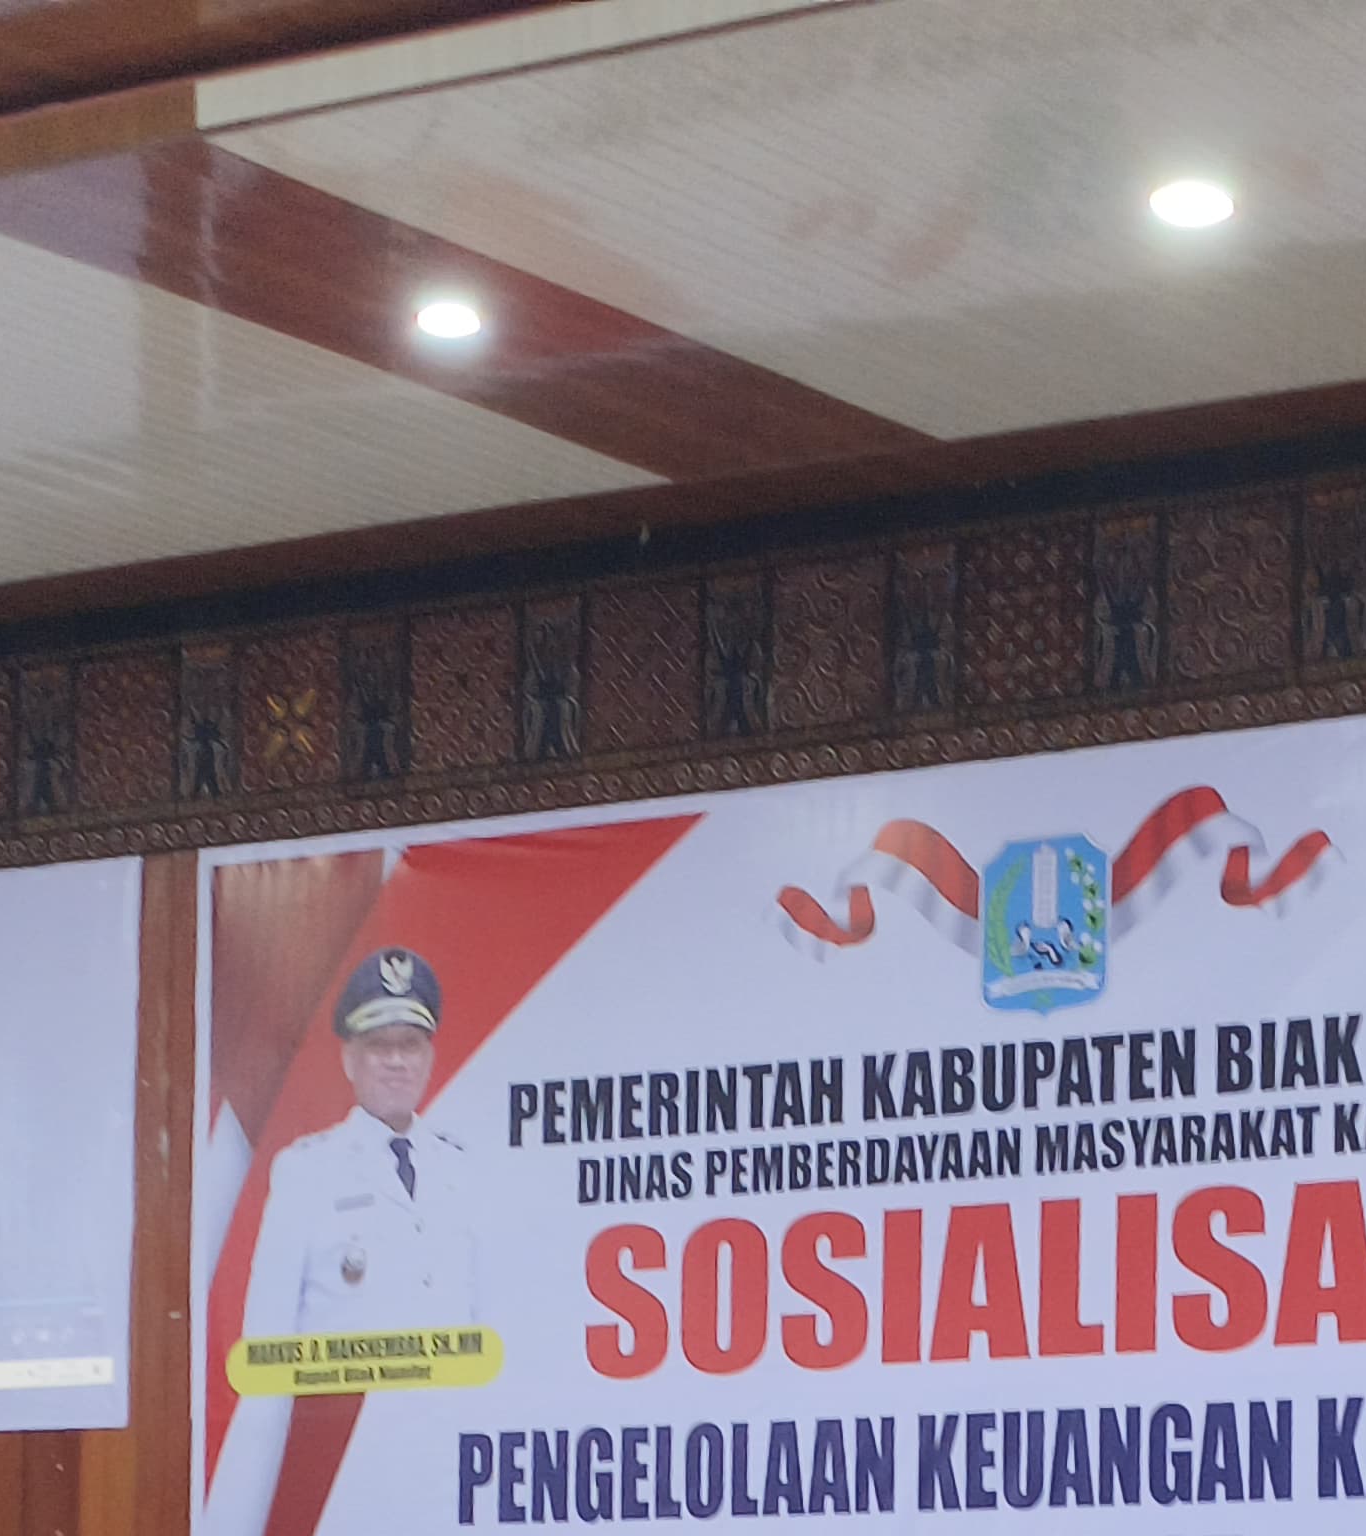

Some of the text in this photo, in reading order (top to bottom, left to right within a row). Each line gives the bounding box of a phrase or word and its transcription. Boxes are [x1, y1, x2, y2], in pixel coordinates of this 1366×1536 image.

[510, 1058, 843, 1147] PEMERINTAH
[863, 1028, 1195, 1121] KABUPATEN
[1217, 1014, 1363, 1094] BIAK
[578, 1152, 692, 1203] DINAS
[706, 1127, 1021, 1196] PEMBERDAYAAN
[1035, 1106, 1320, 1174] MASYARAKAT
[459, 1417, 894, 1525] PENGELOLAAN
[918, 1400, 1292, 1510] KEUANGAN
